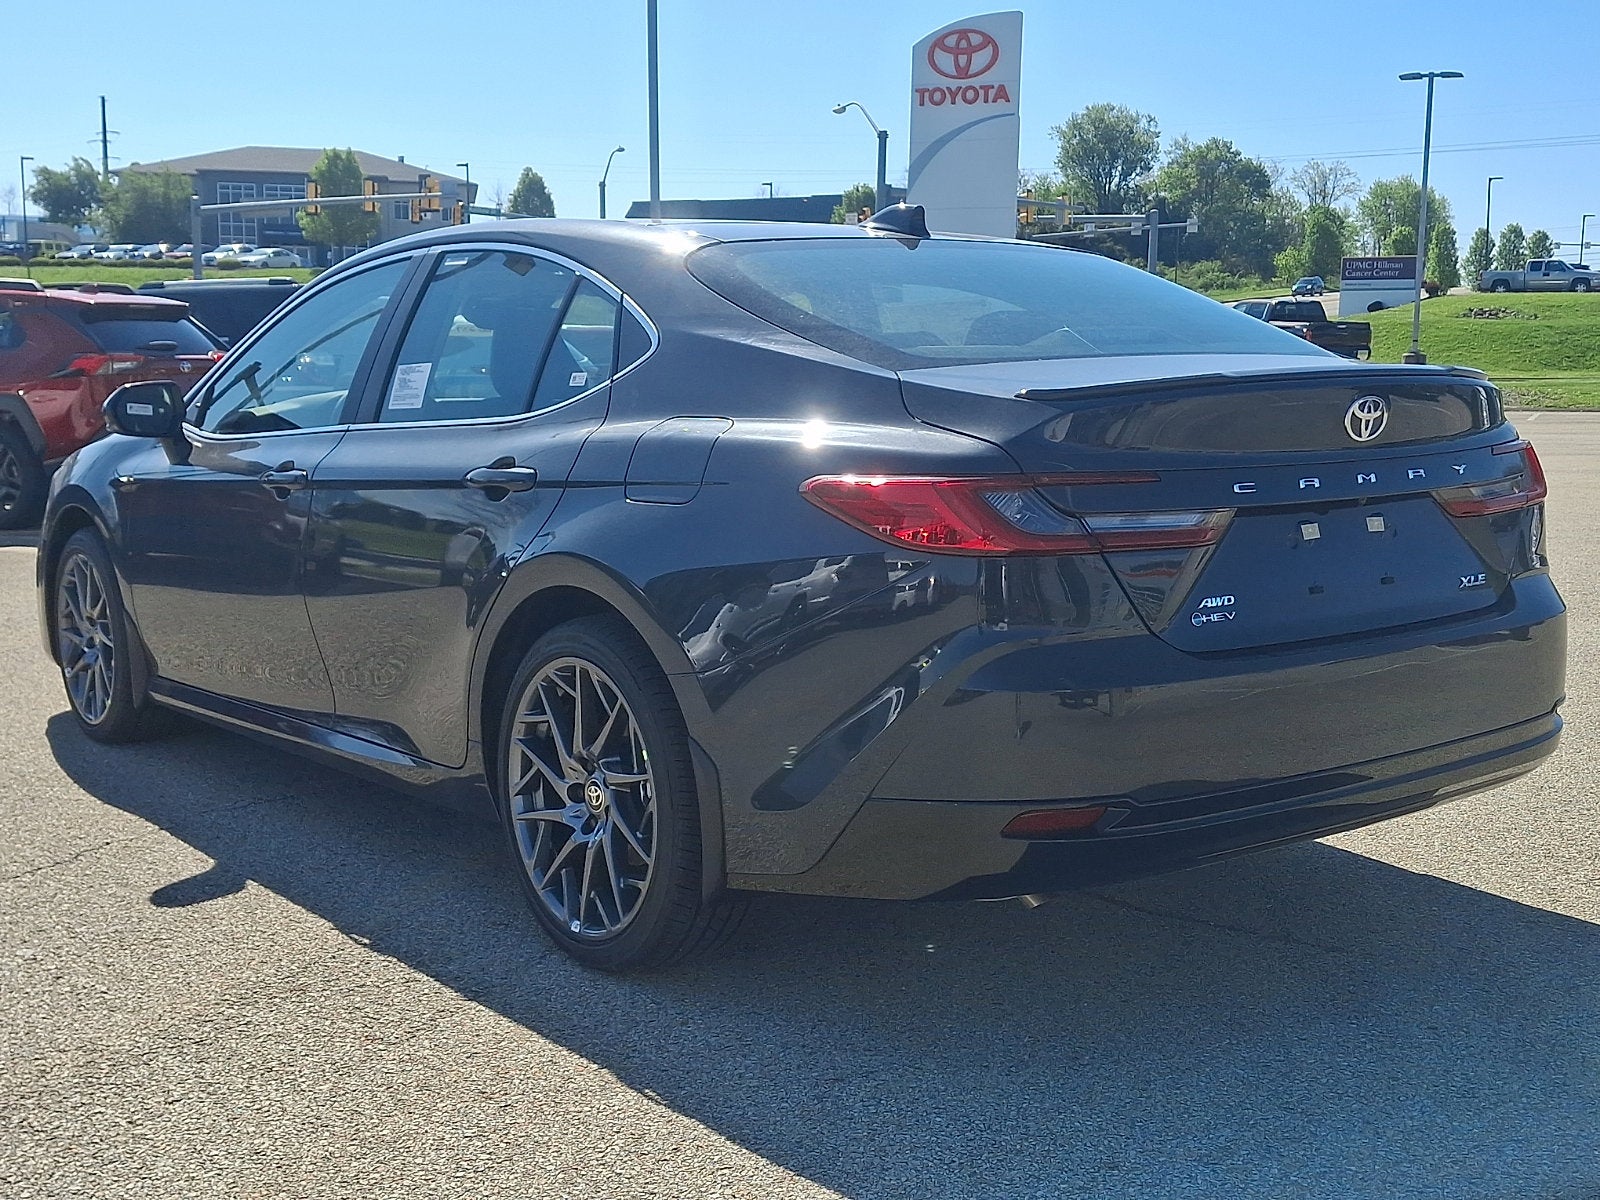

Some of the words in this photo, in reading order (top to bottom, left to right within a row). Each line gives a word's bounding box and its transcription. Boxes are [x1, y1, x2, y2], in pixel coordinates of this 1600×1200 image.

[914, 84, 1011, 107] TOYOTA
[1345, 269, 1372, 277] Cancer
[1373, 268, 1400, 277] Center
[1346, 261, 1372, 269] UPMC
[1373, 261, 1403, 269] Hillman
[1233, 464, 1467, 493] CAMRY
[1459, 573, 1486, 589] XLE
[1198, 595, 1235, 609] AWD
